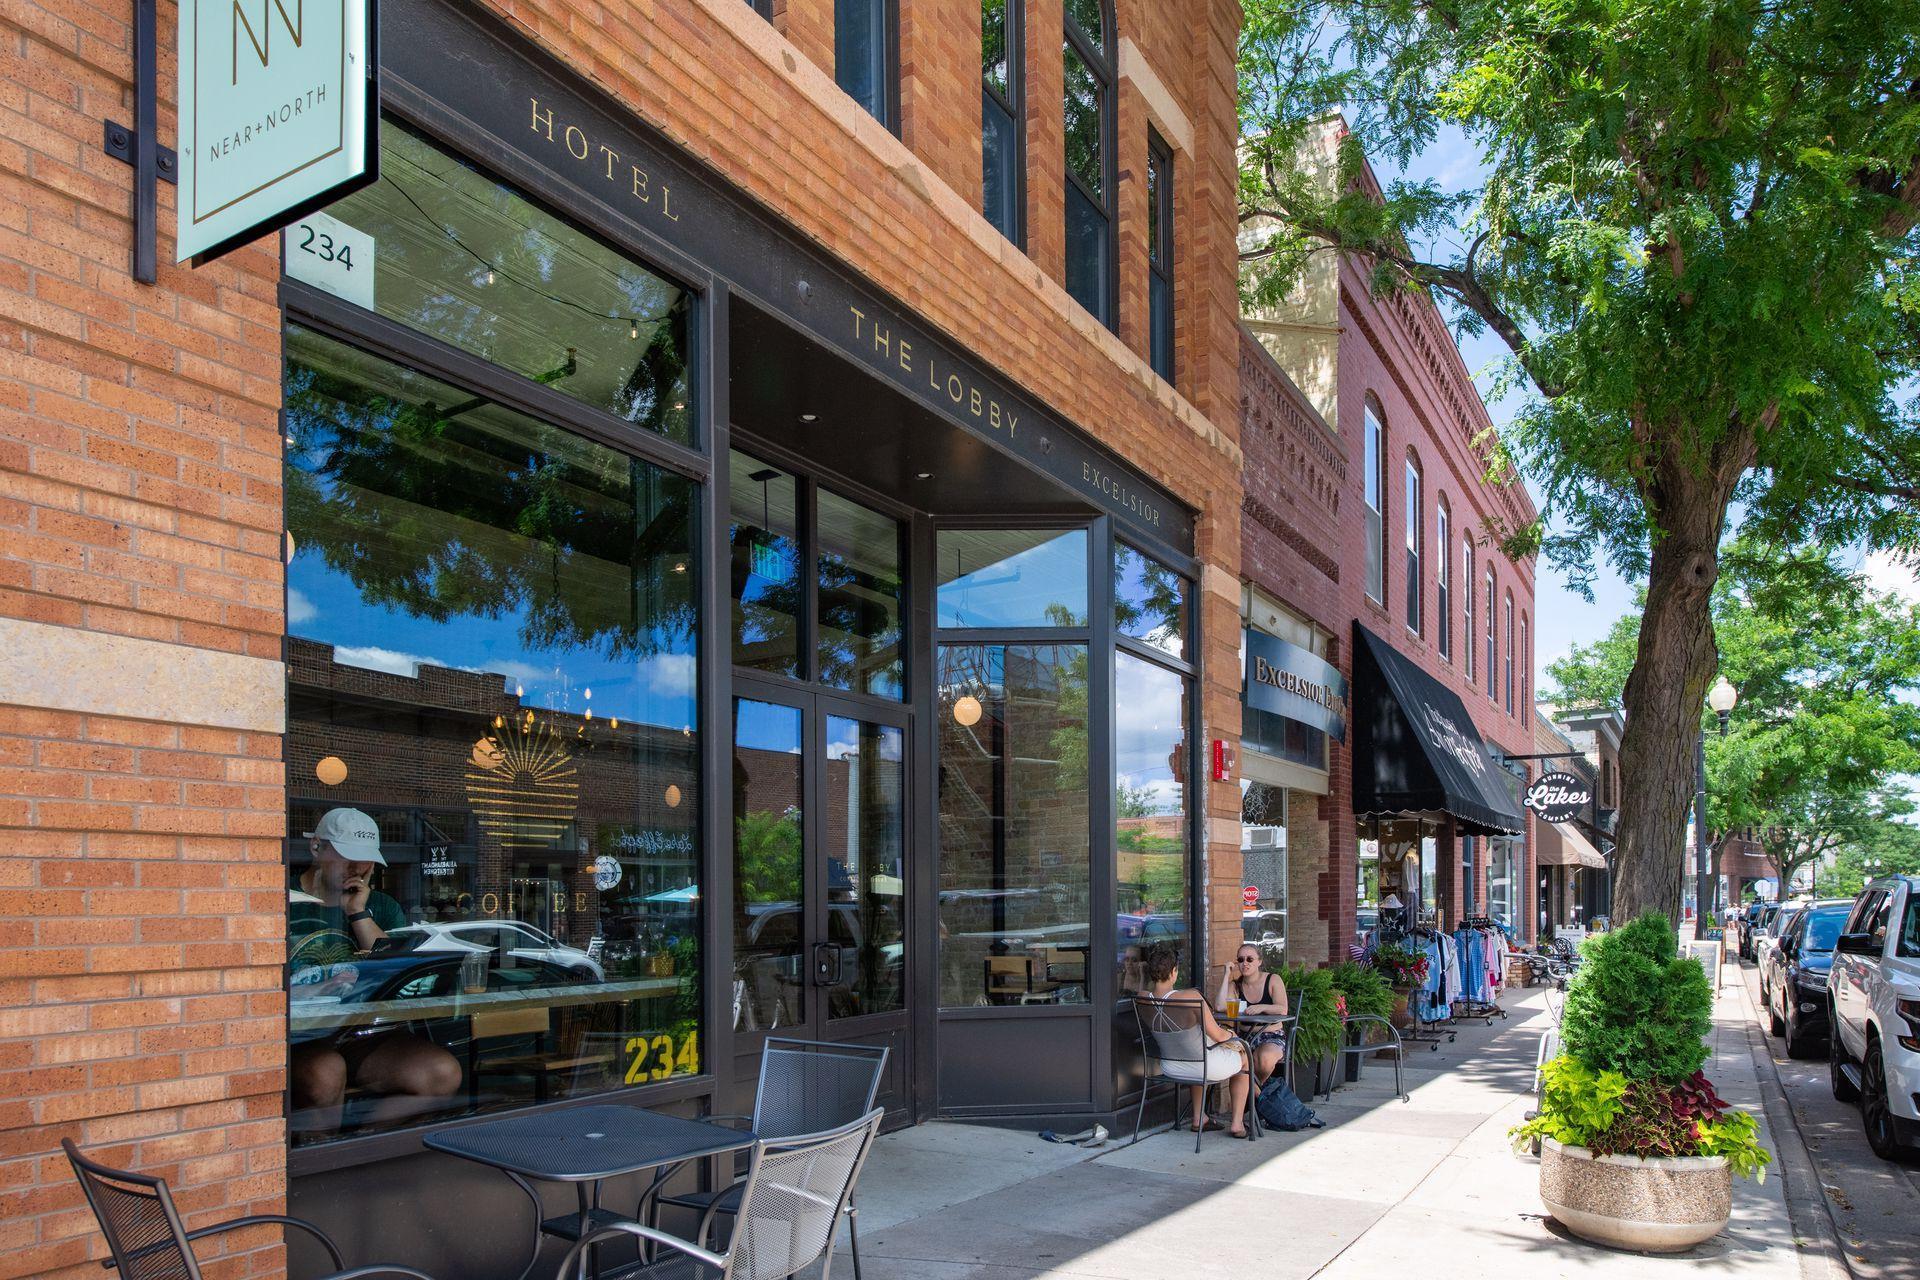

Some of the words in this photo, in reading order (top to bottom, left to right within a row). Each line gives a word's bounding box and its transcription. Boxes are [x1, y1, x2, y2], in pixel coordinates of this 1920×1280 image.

[209, 83, 328, 162] NEAR+NORTH
[530, 97, 679, 222] HOTEL
[299, 224, 354, 271] 234
[850, 306, 912, 372] THE
[930, 360, 1018, 439] LOBBY
[1082, 461, 1160, 527] EXCELSIOR
[1254, 655, 1324, 705] EXCELSIOR
[1523, 784, 1591, 811] Lakes
[1542, 774, 1576, 784] RUNNING
[1538, 811, 1574, 822] COMPANY
[456, 892, 587, 914] COFEE
[624, 1030, 699, 1085] 234
